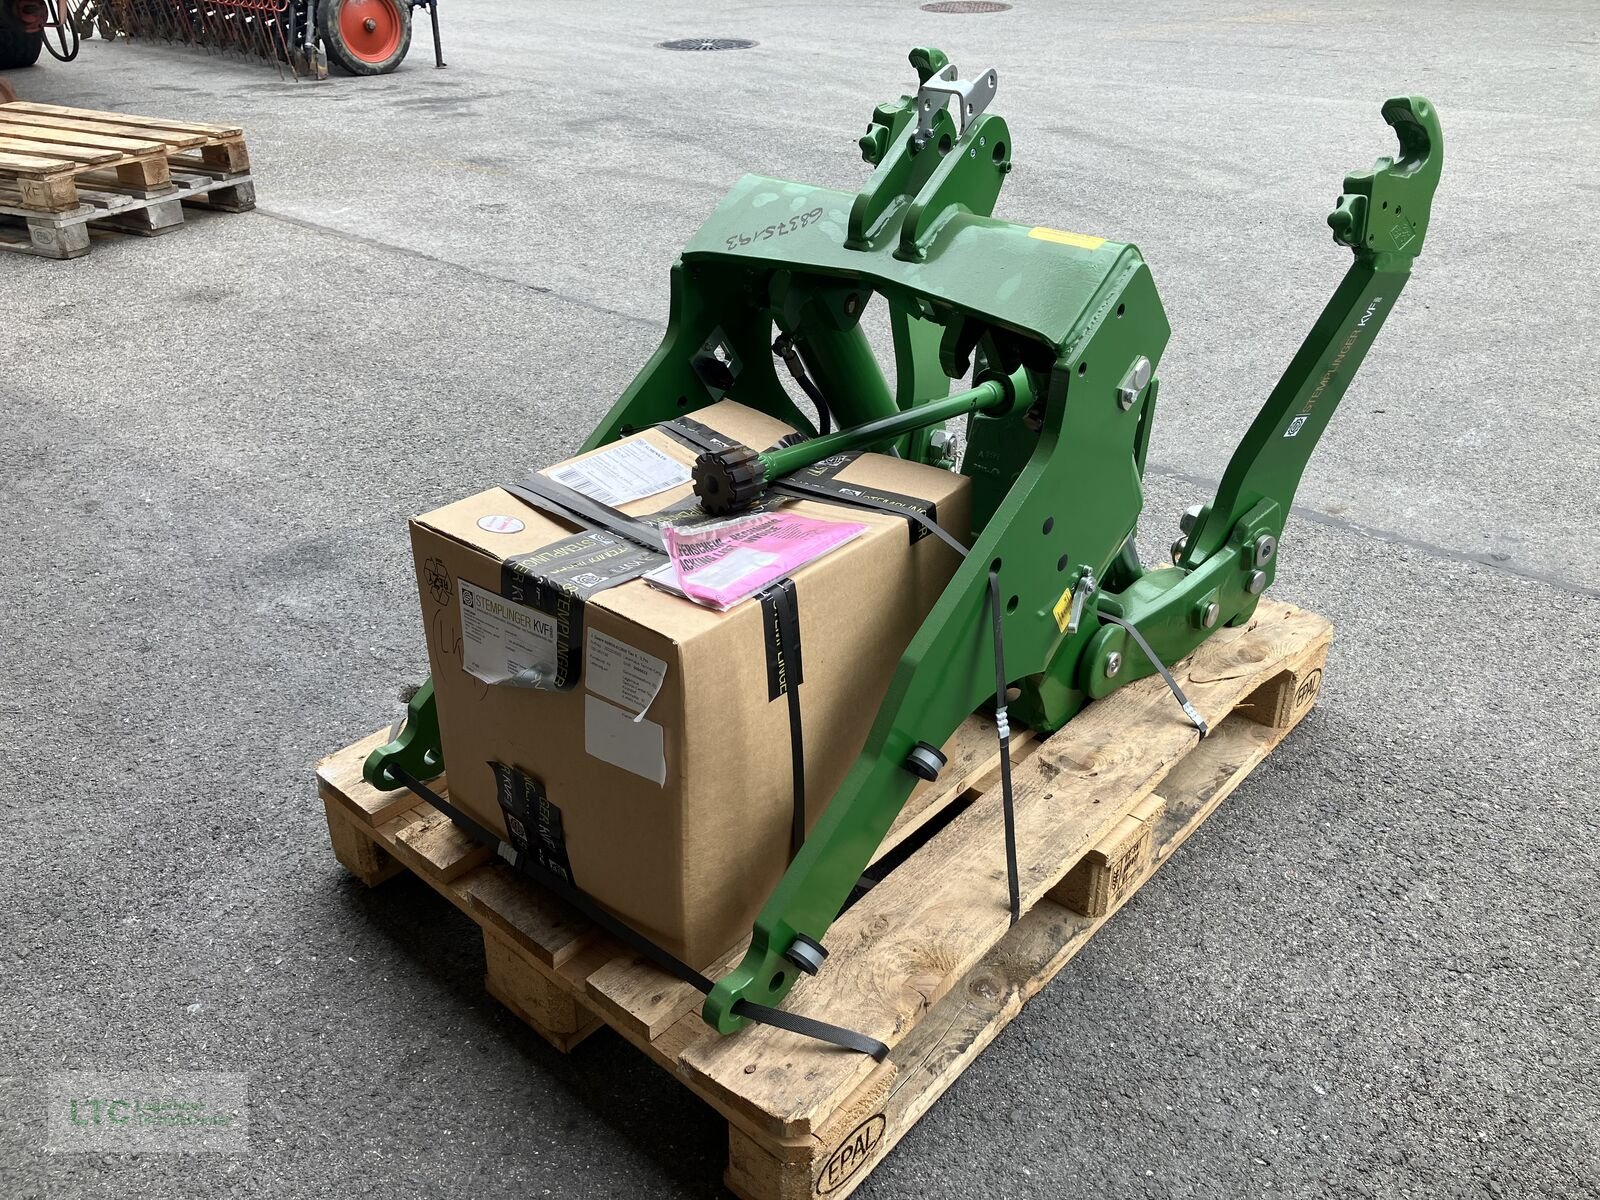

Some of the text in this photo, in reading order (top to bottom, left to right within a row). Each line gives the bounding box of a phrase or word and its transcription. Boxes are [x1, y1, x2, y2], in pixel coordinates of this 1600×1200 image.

[1302, 302, 1377, 414] STEMPLINGER KVF
[680, 552, 717, 573] ACKING
[475, 595, 532, 630] STEMPLINGER
[533, 619, 550, 636] KVF
[554, 583, 578, 688] STEMPLINGER
[828, 1127, 876, 1186] EPAL
